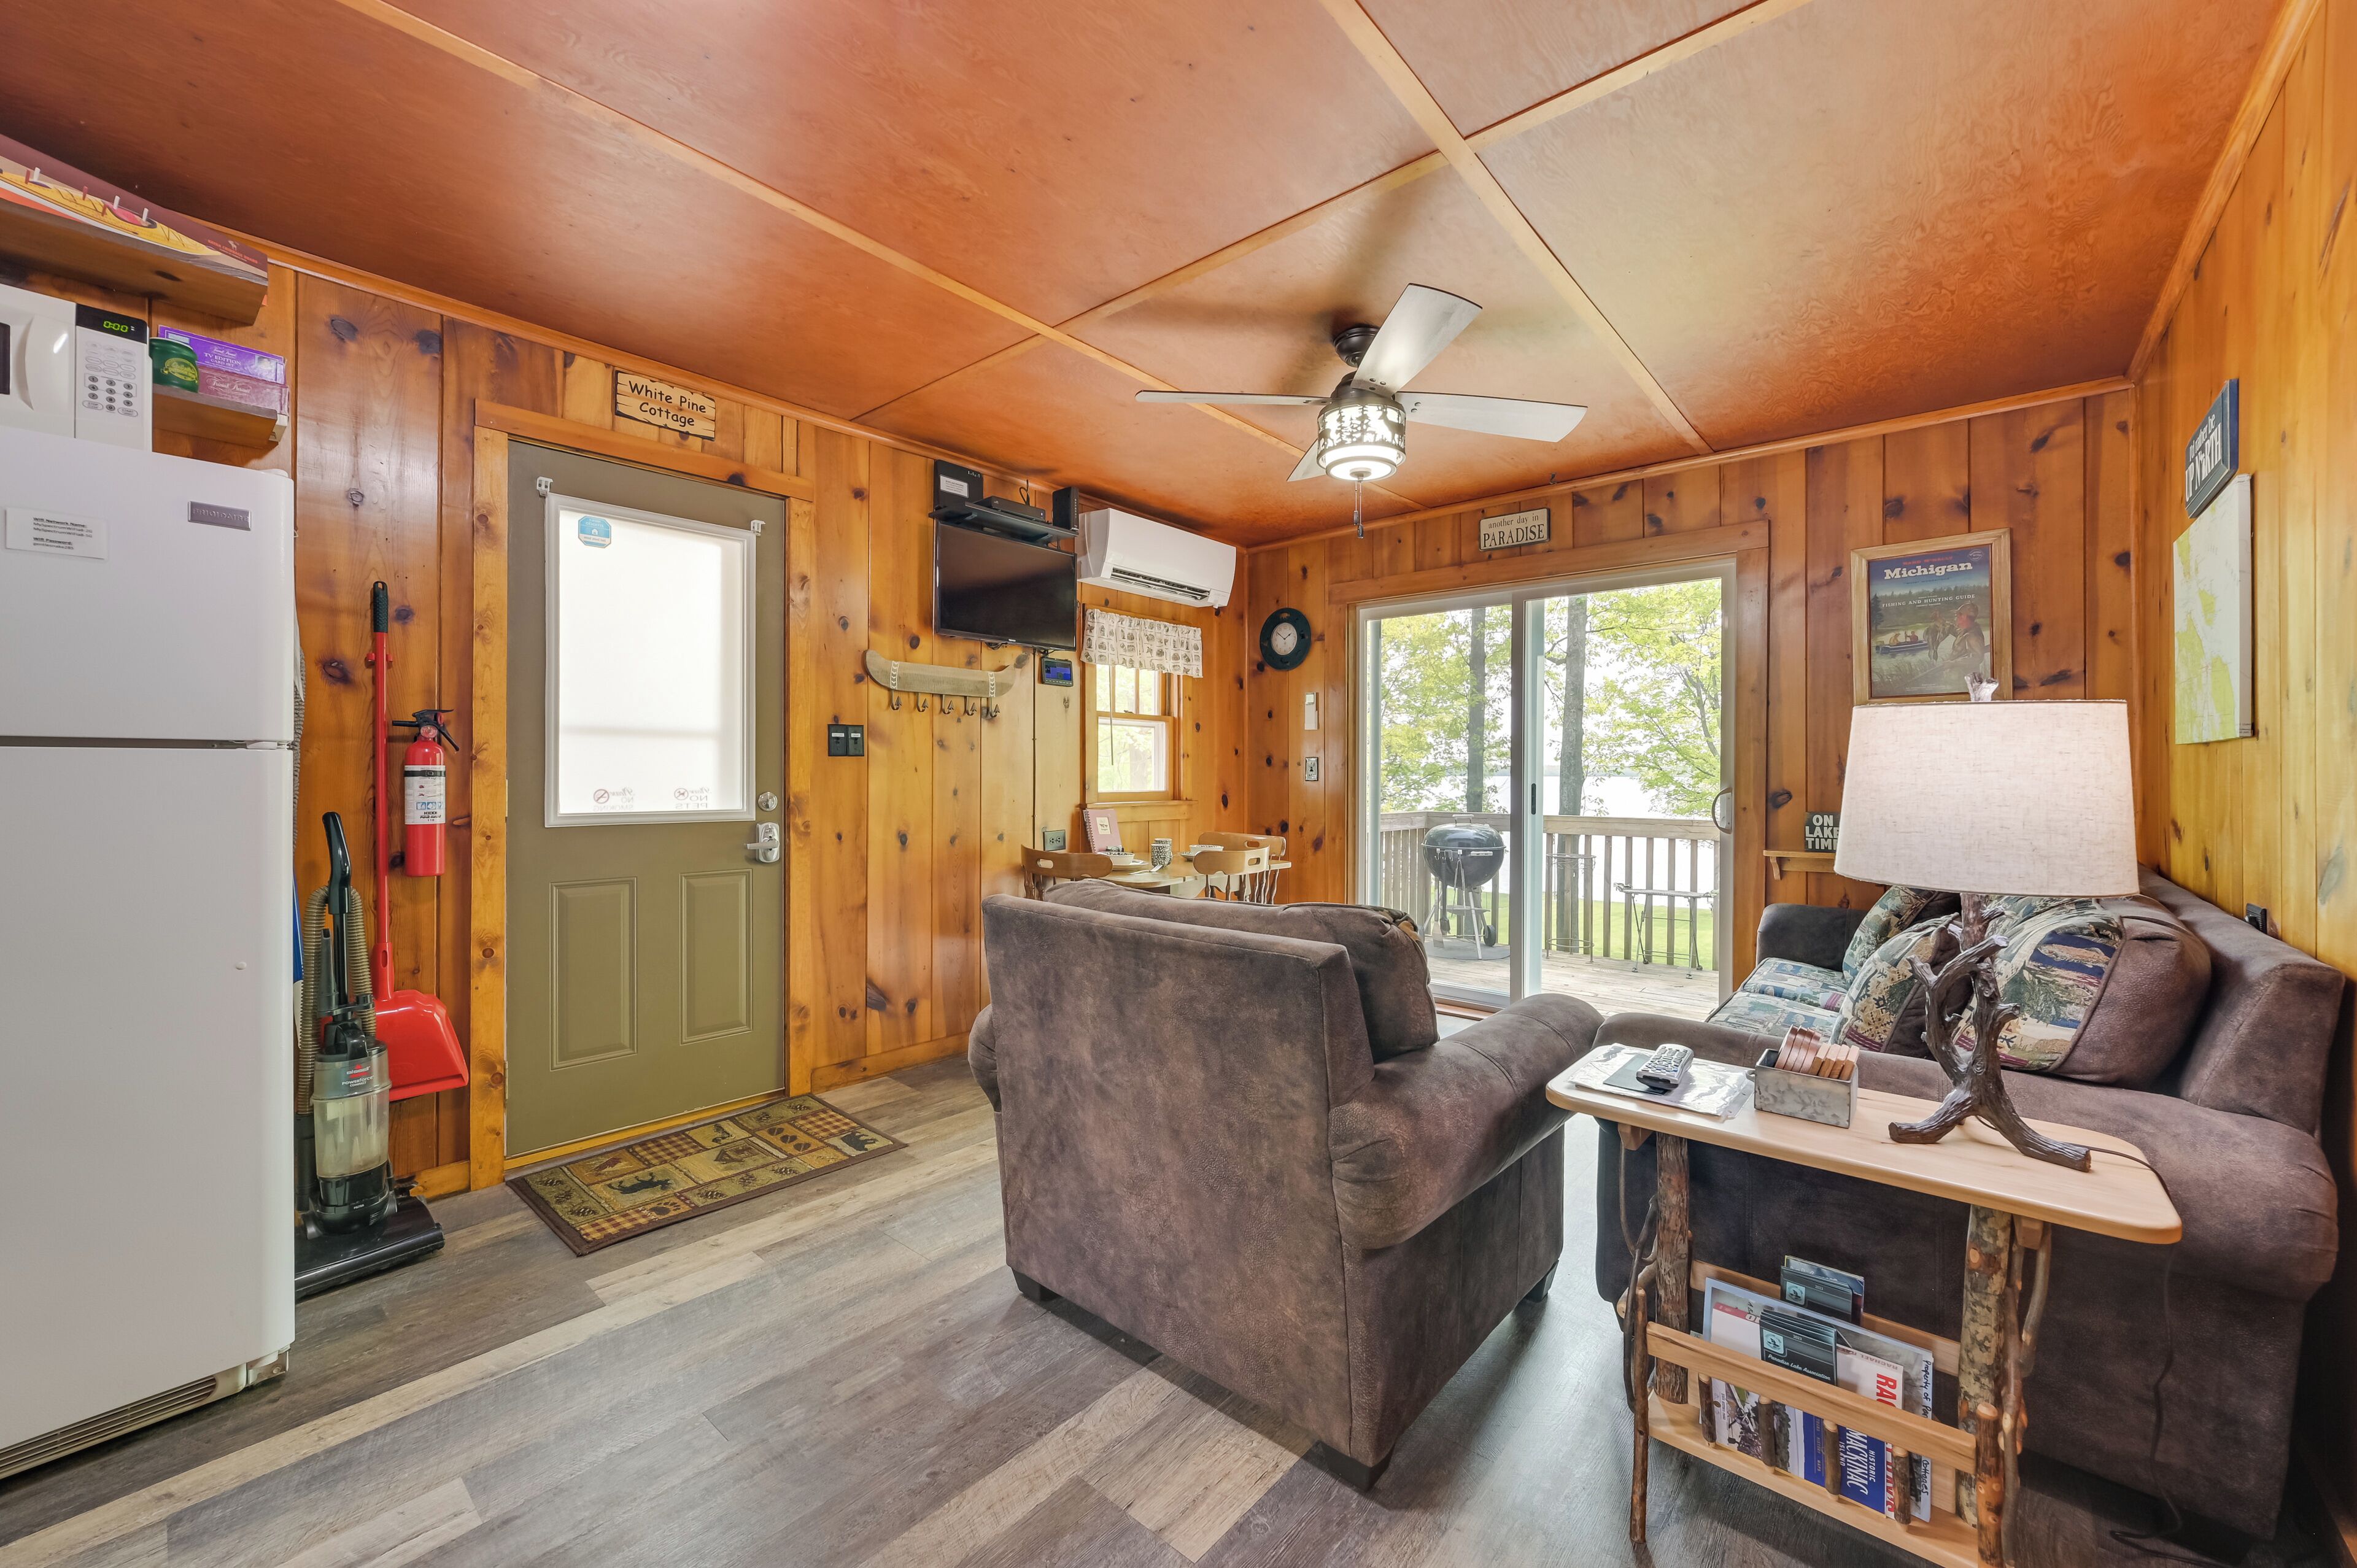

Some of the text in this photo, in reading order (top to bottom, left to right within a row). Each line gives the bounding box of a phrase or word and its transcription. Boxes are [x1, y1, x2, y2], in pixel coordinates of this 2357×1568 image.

[103, 320, 128, 333] 0:00
[215, 356, 241, 366] EDITION
[629, 380, 706, 413] White Pine
[640, 402, 694, 427] Cottage
[2195, 423, 2208, 453] rather
[2208, 414, 2215, 434] be
[2185, 462, 2194, 503] UP
[193, 508, 249, 522] FRIGIDAIRE
[1488, 513, 1539, 529] another day in
[1483, 523, 1544, 547] PARADISE
[1884, 562, 1973, 580] Michigan
[1805, 825, 1840, 838] LAKE
[1812, 814, 1833, 827] ON
[1768, 1354, 1831, 1381] Paradise Lake Association
[1919, 1360, 1932, 1390] Property
[1923, 1392, 1931, 1402] of
[1844, 1427, 1868, 1496] MACKINAC
[1921, 1459, 1930, 1496] Cottages
